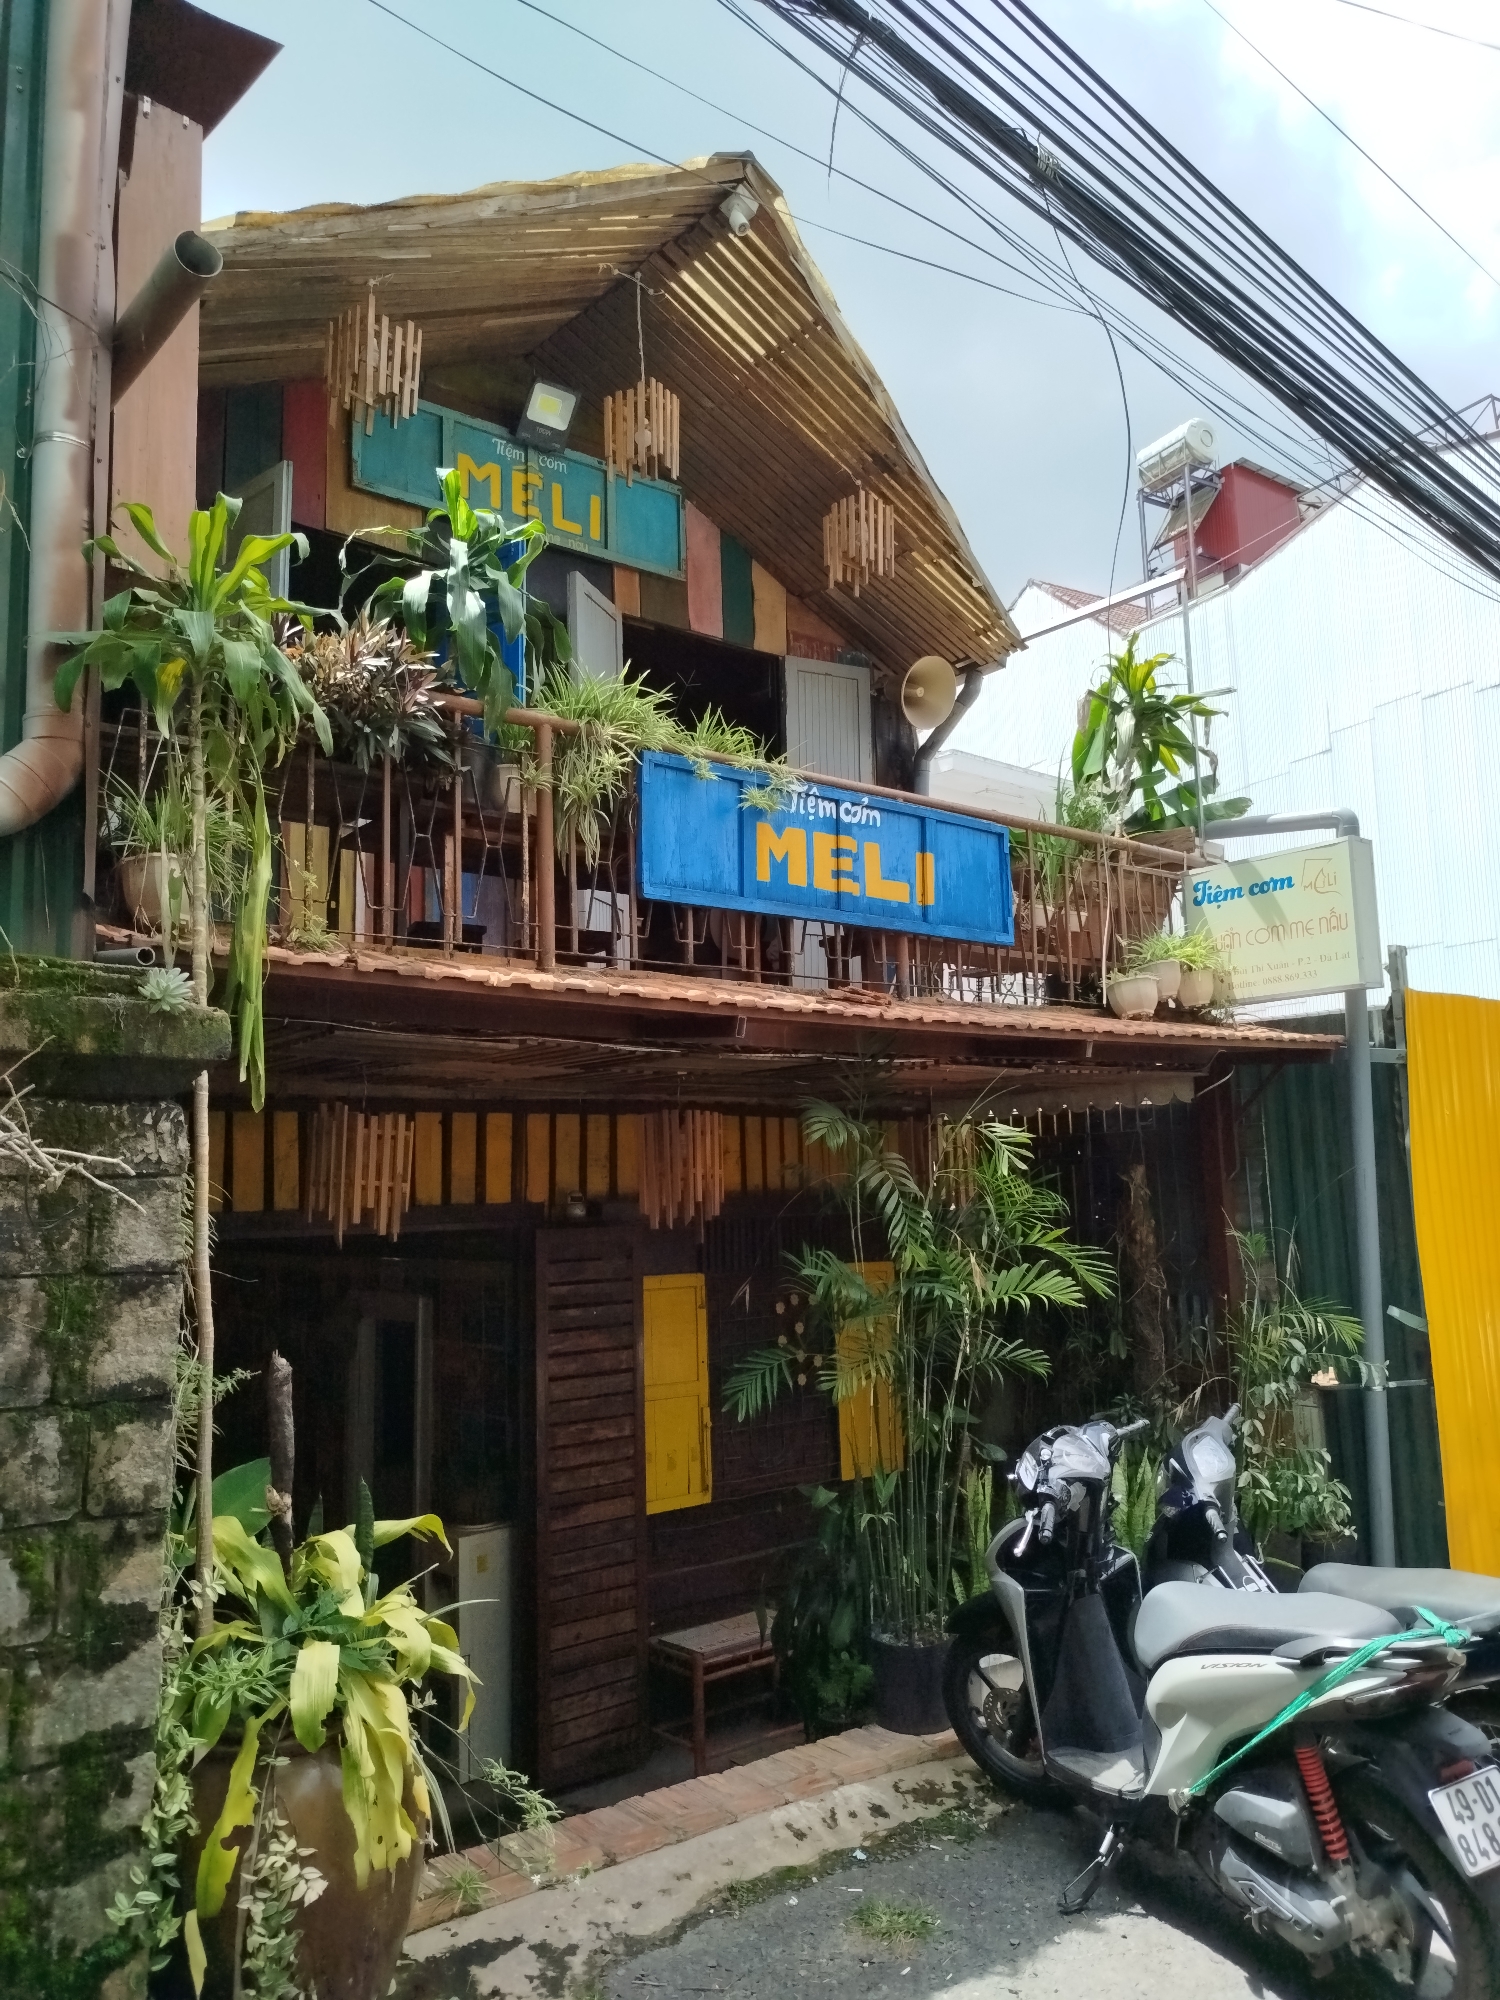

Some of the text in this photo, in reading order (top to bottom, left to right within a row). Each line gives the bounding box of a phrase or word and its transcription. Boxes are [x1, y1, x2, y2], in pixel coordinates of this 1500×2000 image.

[492, 438, 525, 463] Tiệm
[789, 785, 837, 821] Tiệm
[756, 822, 935, 906] MELI
[1193, 876, 1295, 909] Tiệm cơm
[1200, 1662, 1268, 1670] VISION
[1457, 1816, 1500, 1868] 848
